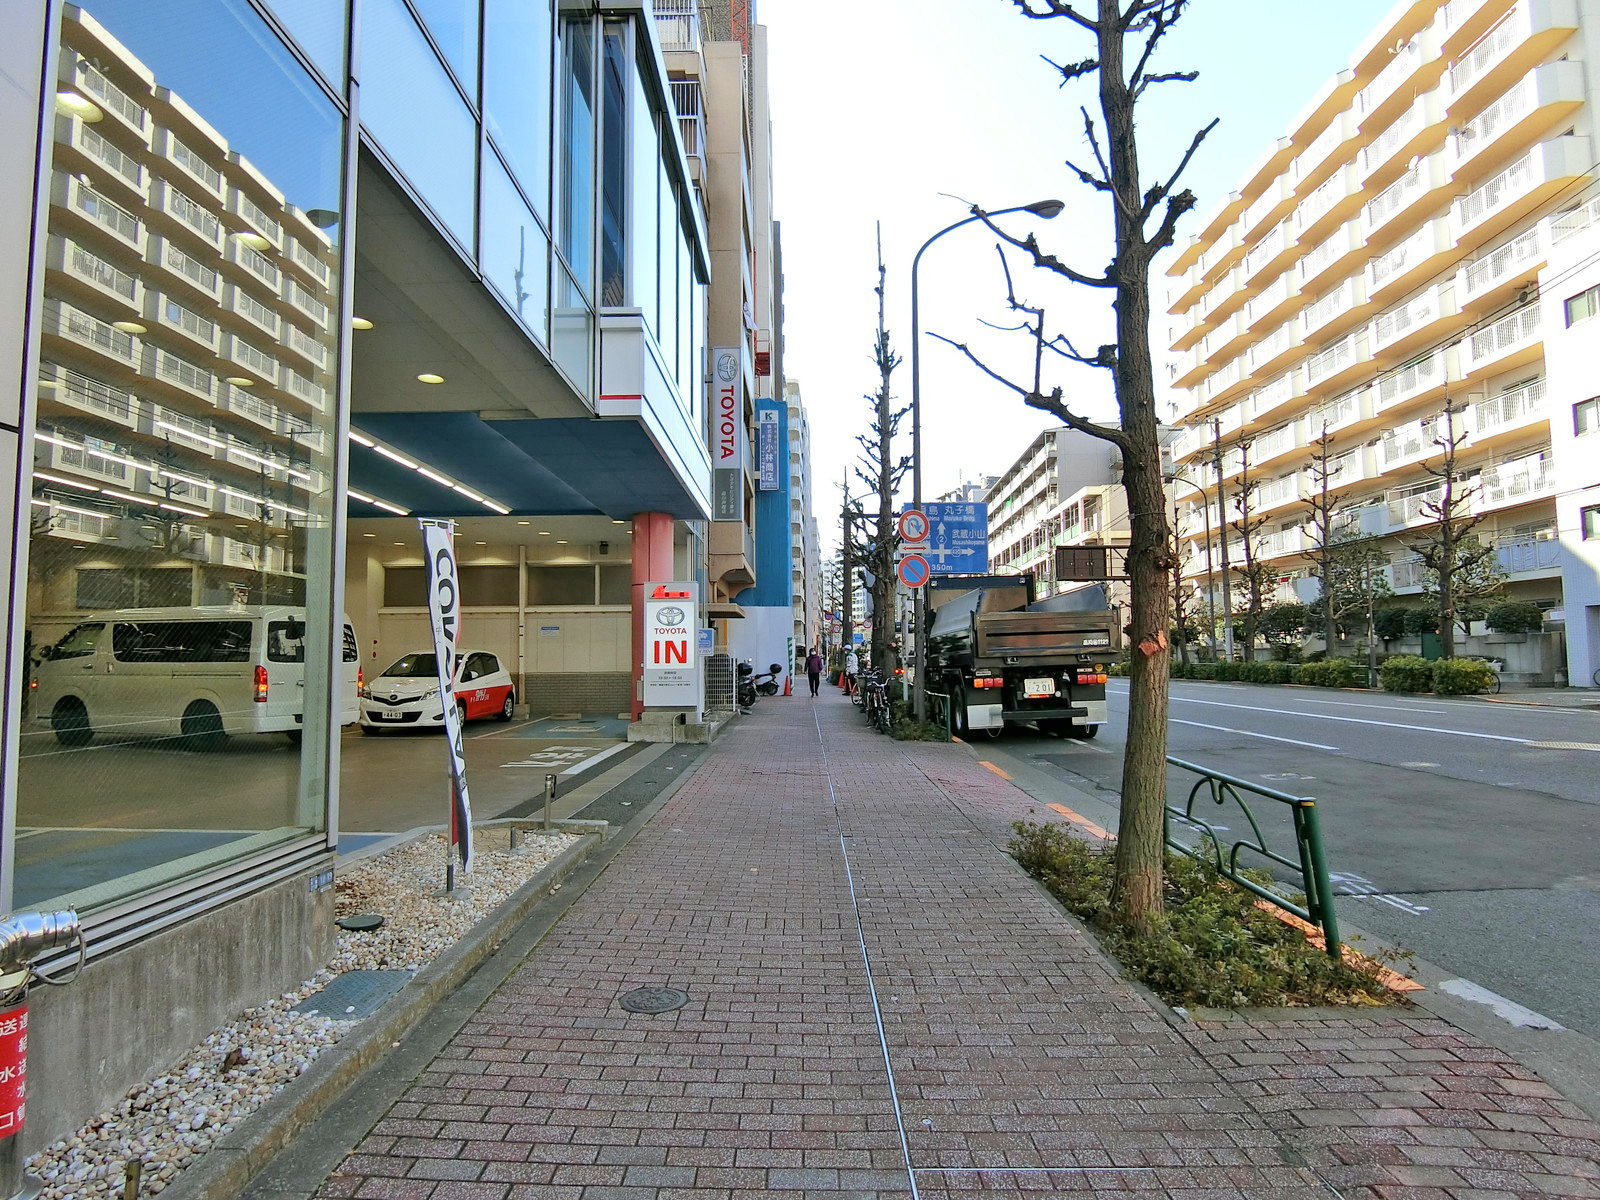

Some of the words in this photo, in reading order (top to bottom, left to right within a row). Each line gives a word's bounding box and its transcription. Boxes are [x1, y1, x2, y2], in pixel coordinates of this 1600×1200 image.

[721, 386, 735, 460] TOYOTA
[944, 504, 975, 516] 丸子橋
[951, 529, 986, 539] 武蔵小山
[931, 563, 953, 571] 350m
[654, 640, 687, 664] IN
